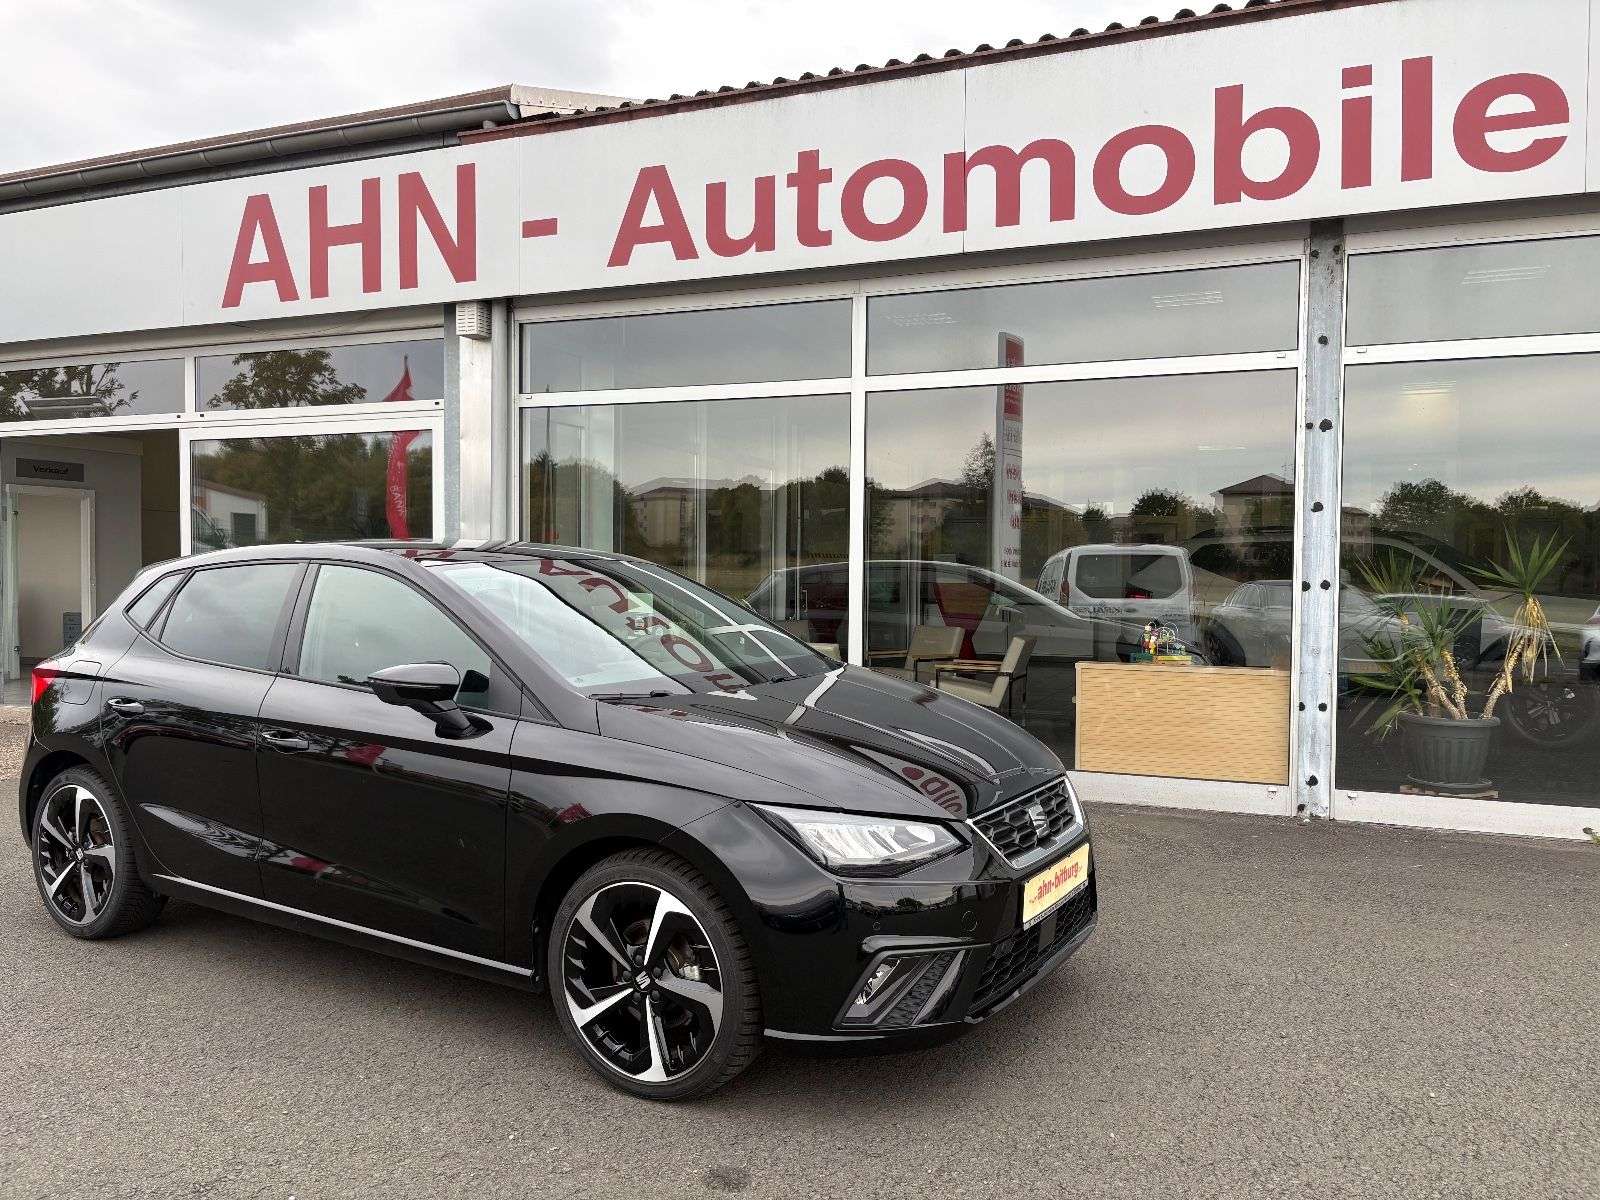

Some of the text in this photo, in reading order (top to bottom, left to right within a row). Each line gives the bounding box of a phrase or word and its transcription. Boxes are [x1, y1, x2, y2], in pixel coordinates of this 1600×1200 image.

[223, 57, 1570, 308] AHN - Automobile
